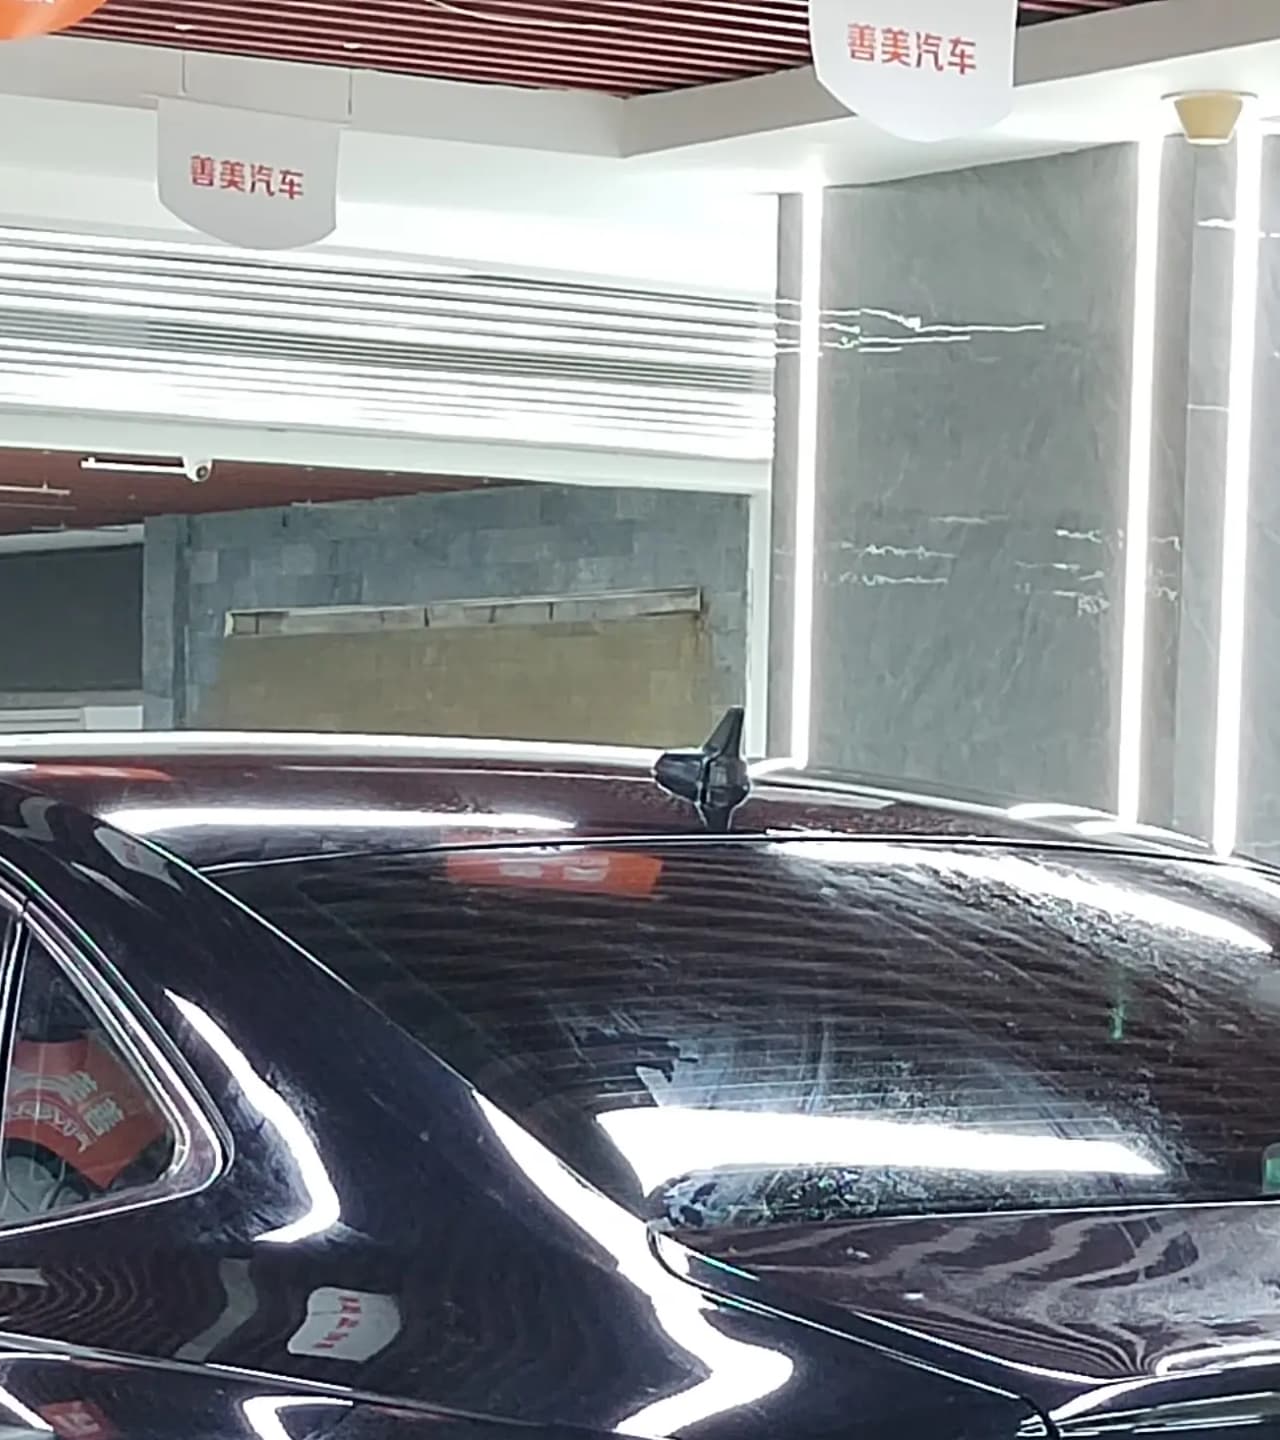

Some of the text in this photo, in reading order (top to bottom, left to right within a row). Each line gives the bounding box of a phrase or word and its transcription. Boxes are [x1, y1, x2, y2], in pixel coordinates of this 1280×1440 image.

[846, 23, 977, 75] 善美汽车
[190, 154, 304, 201] 善美汽车
